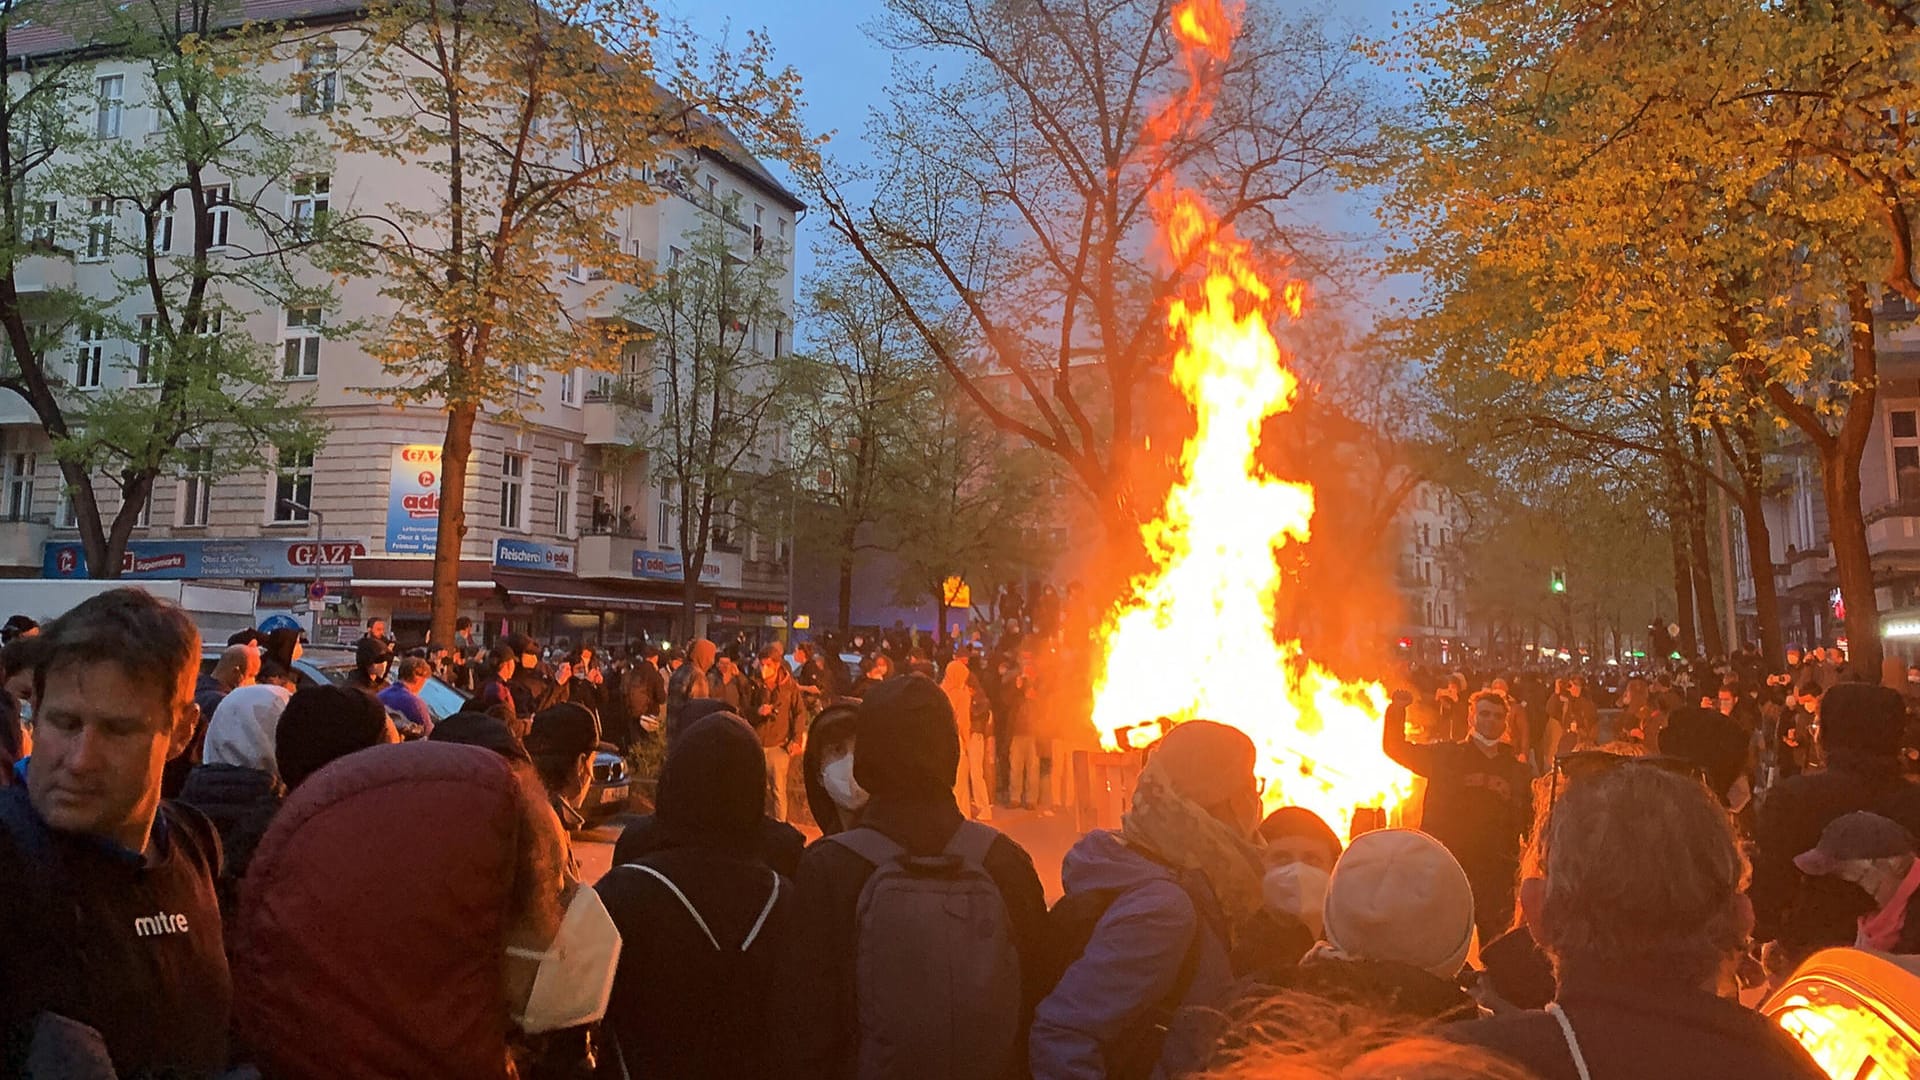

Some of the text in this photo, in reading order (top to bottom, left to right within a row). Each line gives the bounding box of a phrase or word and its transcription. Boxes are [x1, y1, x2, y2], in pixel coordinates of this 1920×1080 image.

[135, 556, 183, 571] Supermarkt
[500, 546, 542, 564] Fleischerei
[135, 911, 189, 937] mitre
